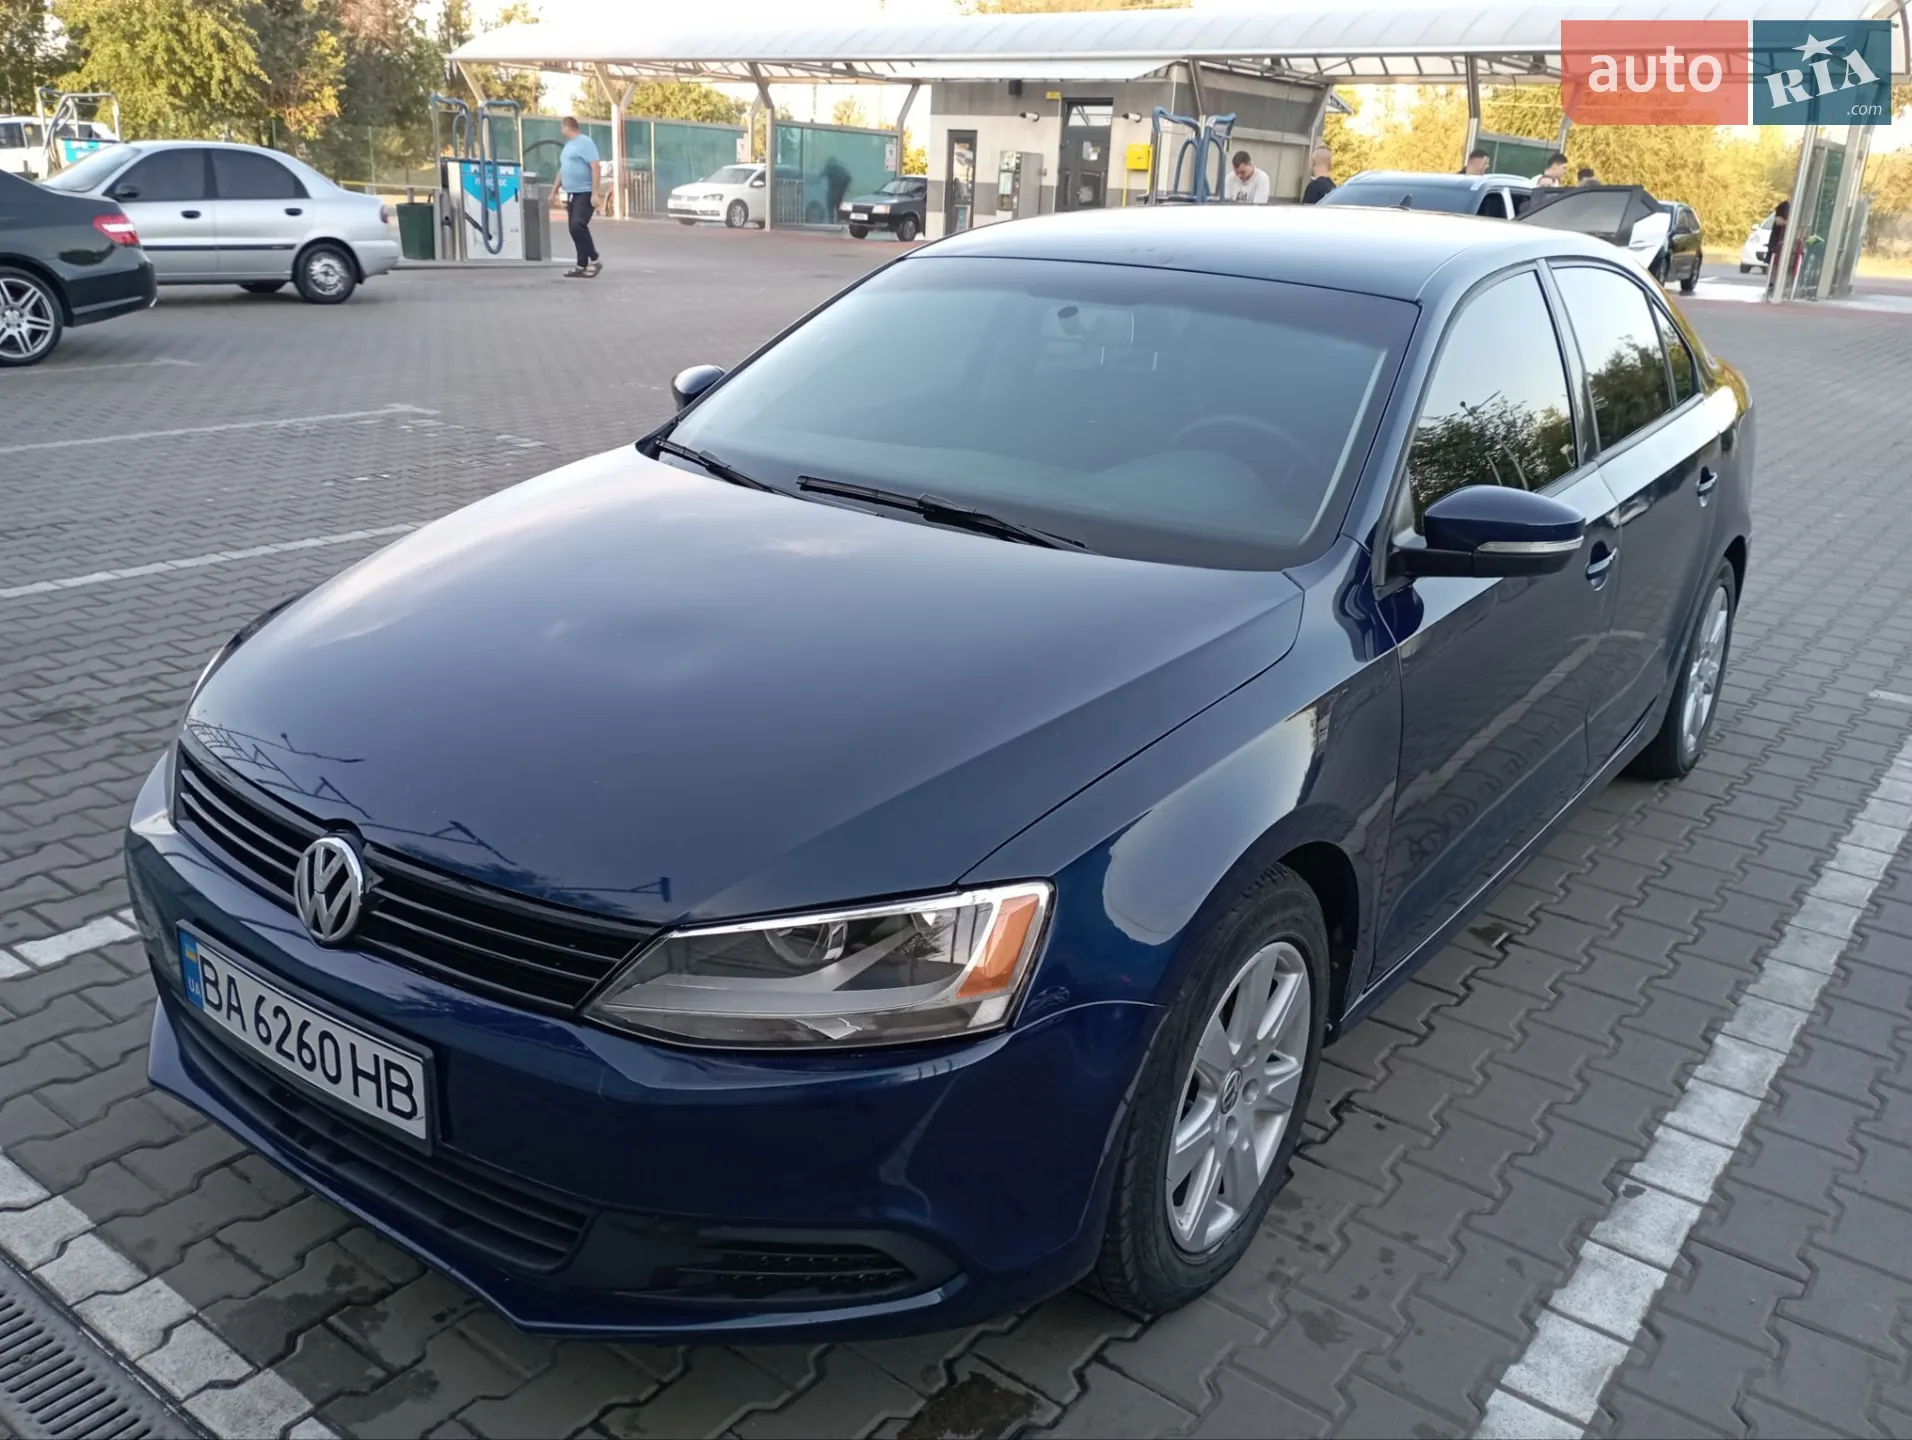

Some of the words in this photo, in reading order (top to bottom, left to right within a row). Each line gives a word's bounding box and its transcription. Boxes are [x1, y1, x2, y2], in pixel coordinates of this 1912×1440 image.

[187, 976, 201, 996] UA
[200, 954, 247, 1033] BA
[253, 994, 343, 1085] 6260
[350, 1041, 418, 1121] HB
